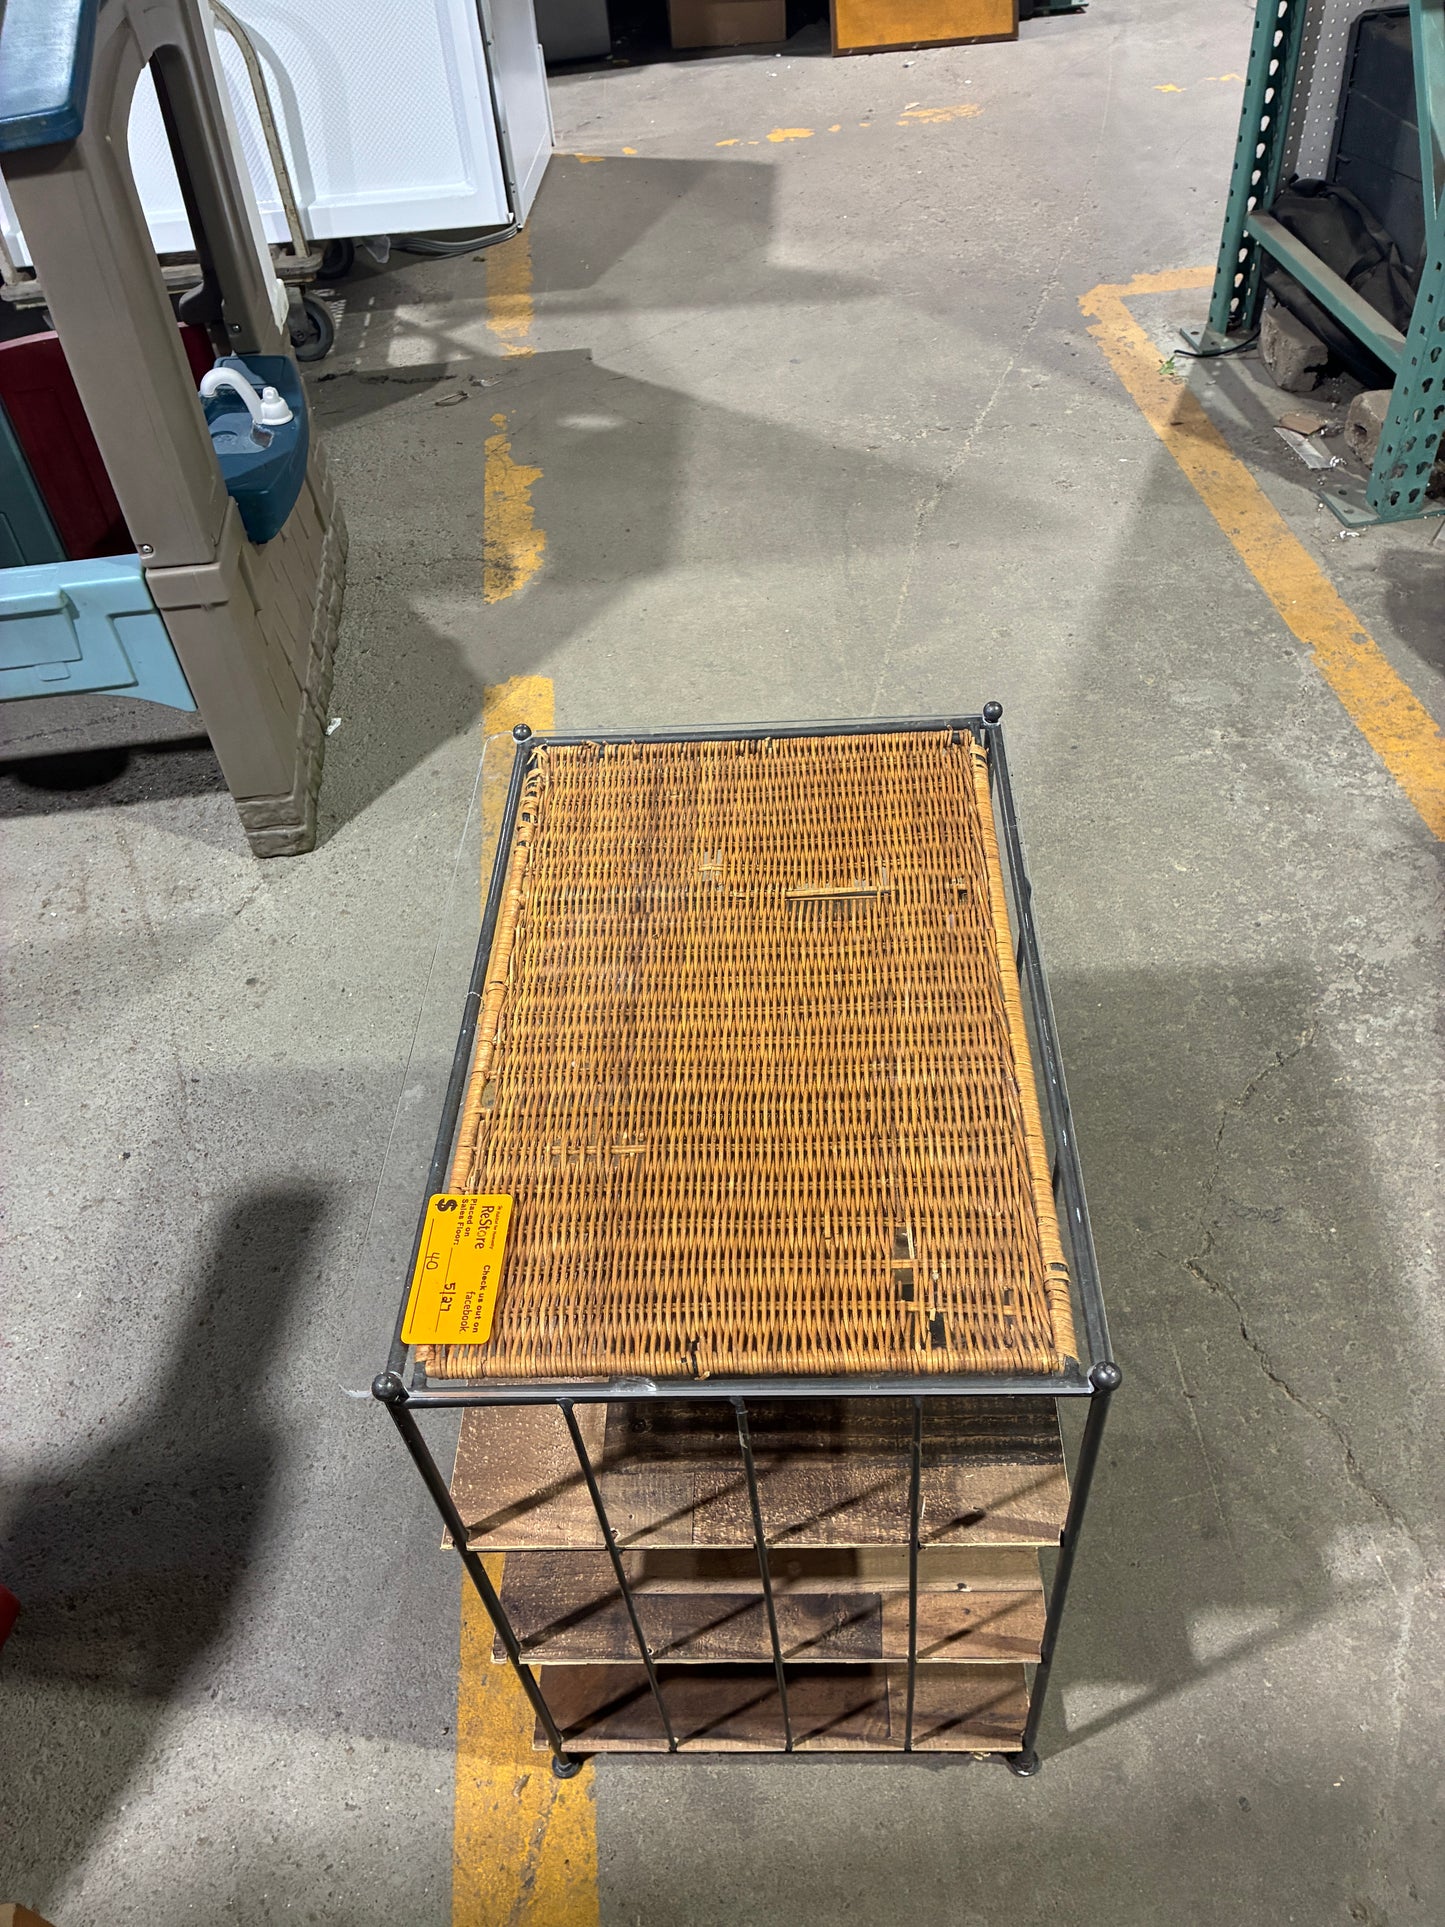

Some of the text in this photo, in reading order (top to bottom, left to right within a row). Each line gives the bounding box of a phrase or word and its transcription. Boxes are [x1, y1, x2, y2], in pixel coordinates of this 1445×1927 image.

[458, 1198, 469, 1219] Sales
[464, 1198, 478, 1237] Placed on
[425, 1197, 458, 1270] $ 40
[453, 1222, 465, 1245] Floor:
[474, 1205, 495, 1249] ReStore
[480, 1264, 491, 1290] Check
[478, 1293, 484, 1303] us
[472, 1322, 479, 1333] on
